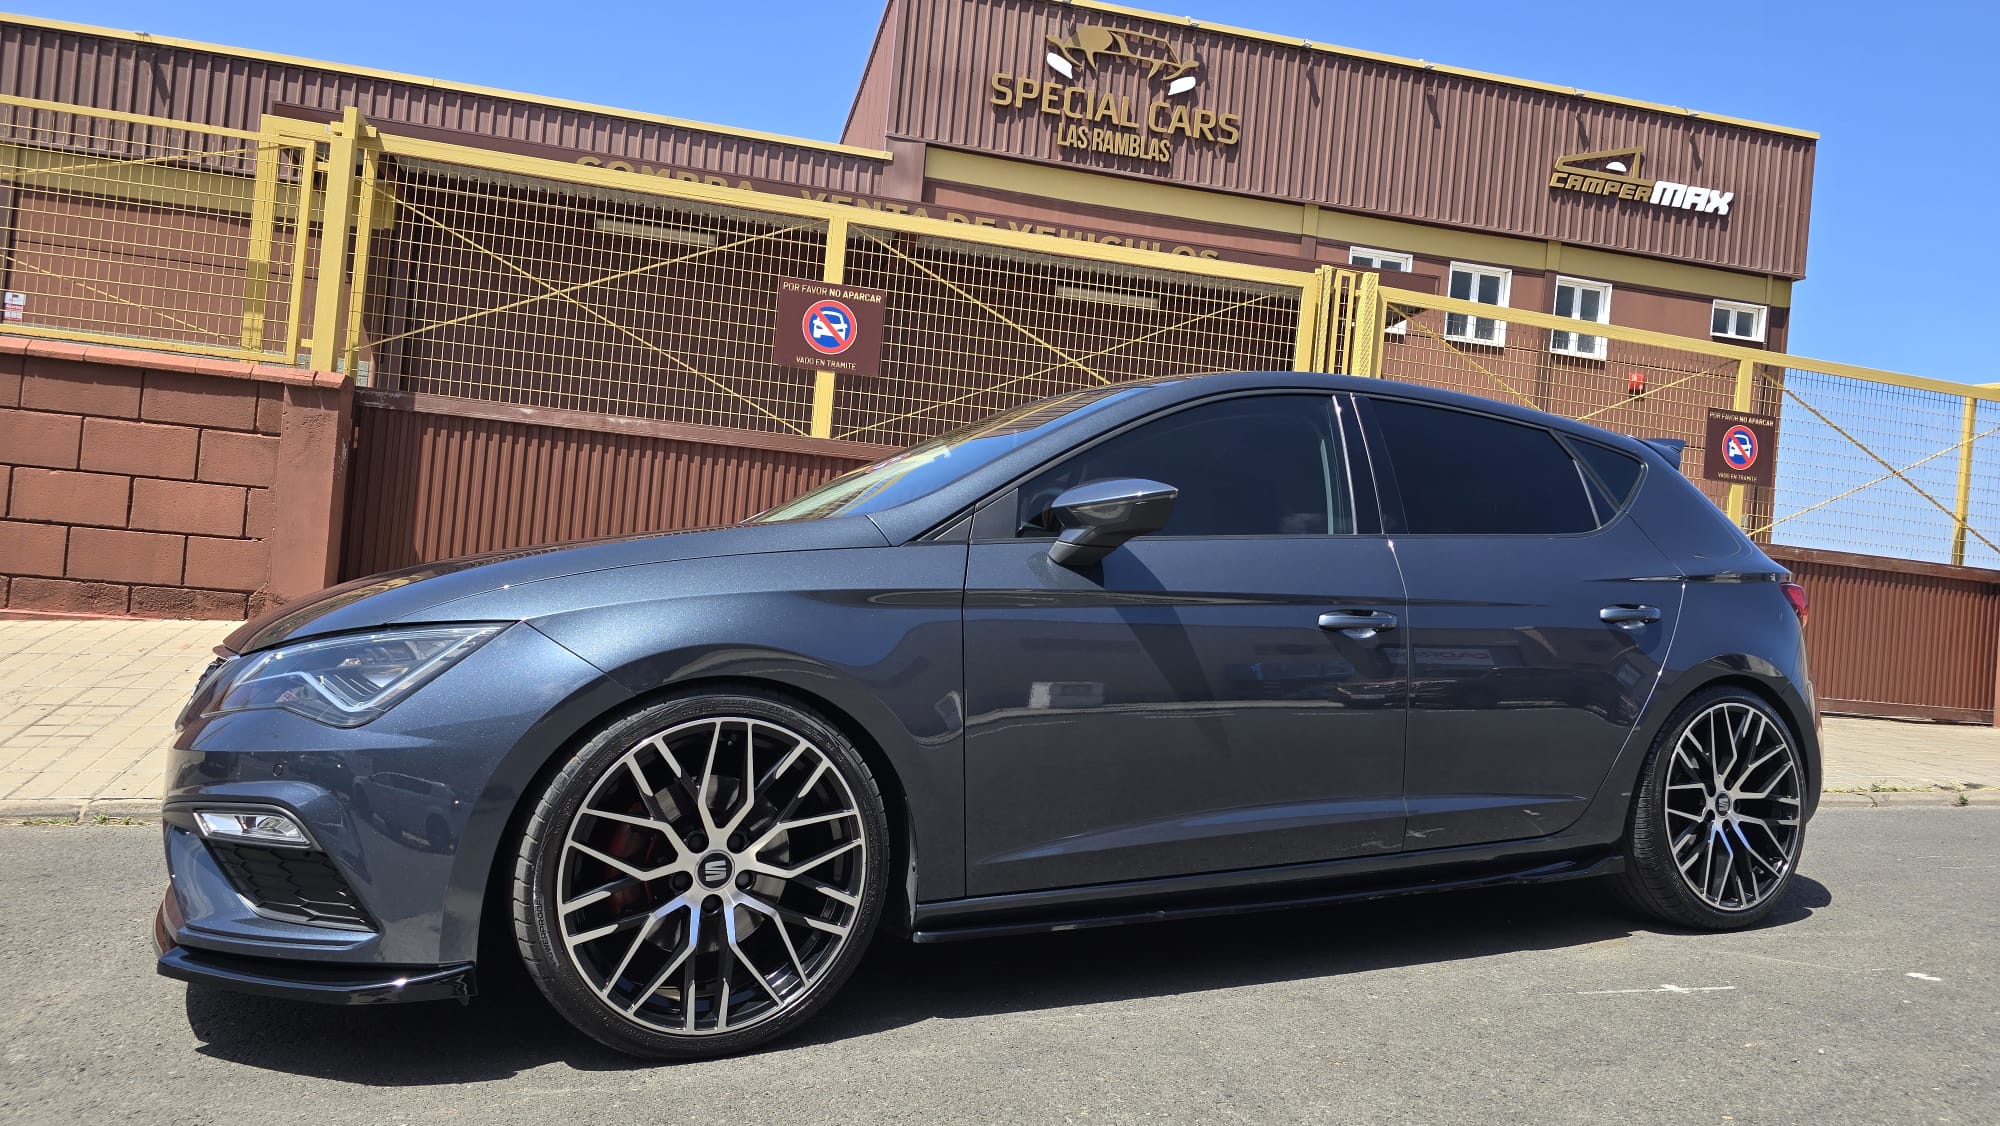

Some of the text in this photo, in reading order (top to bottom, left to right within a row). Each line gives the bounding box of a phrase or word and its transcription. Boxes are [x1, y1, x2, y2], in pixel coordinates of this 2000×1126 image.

[990, 73, 1240, 145] SPECIAL CARS
[1057, 122, 1171, 163] LAS RAMBLAS
[783, 281, 882, 304] POR FAVOR NO APARCAR
[796, 356, 857, 371] VADO EN TRAMITE
